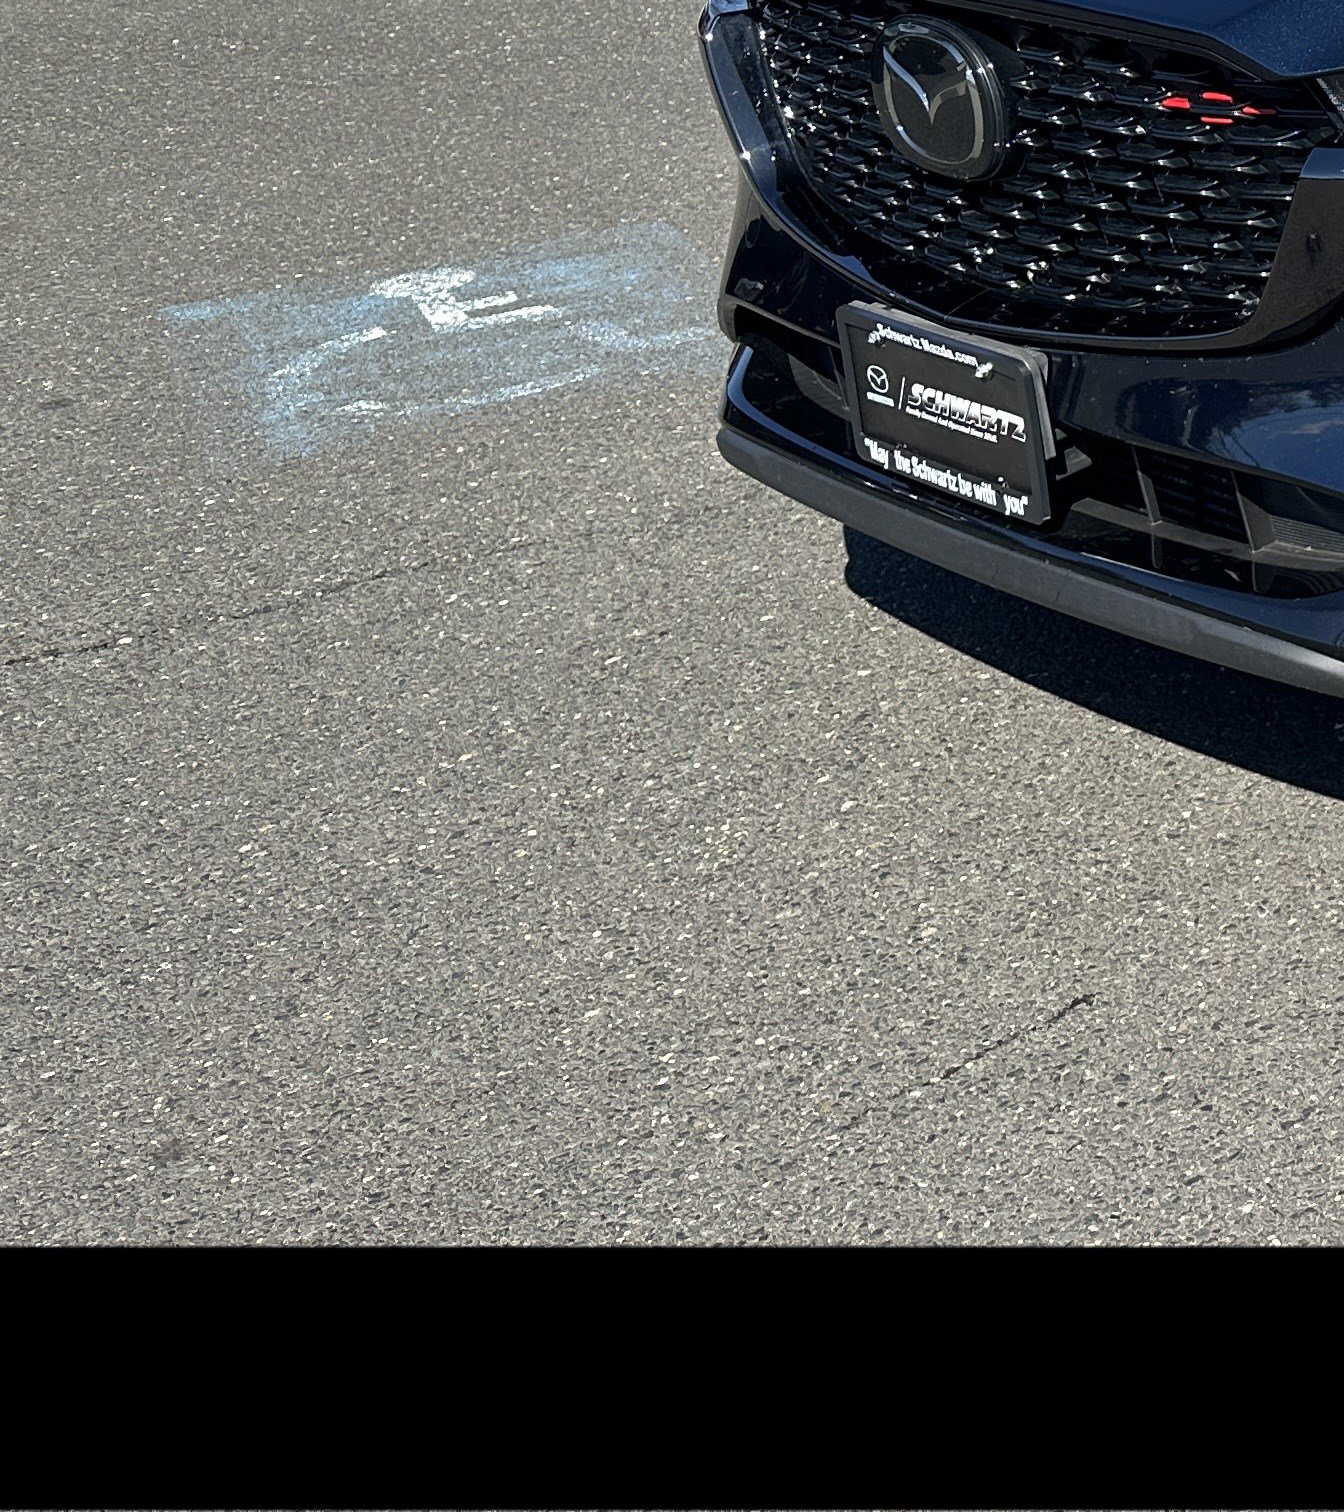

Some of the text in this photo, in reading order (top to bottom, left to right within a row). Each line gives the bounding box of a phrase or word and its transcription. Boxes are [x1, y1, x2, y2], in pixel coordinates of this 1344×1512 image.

[907, 382, 1027, 444] SCHWARTZ
[894, 449, 911, 474] the
[911, 455, 959, 492] Schwartz
[957, 472, 974, 498] be
[973, 481, 997, 506] with
